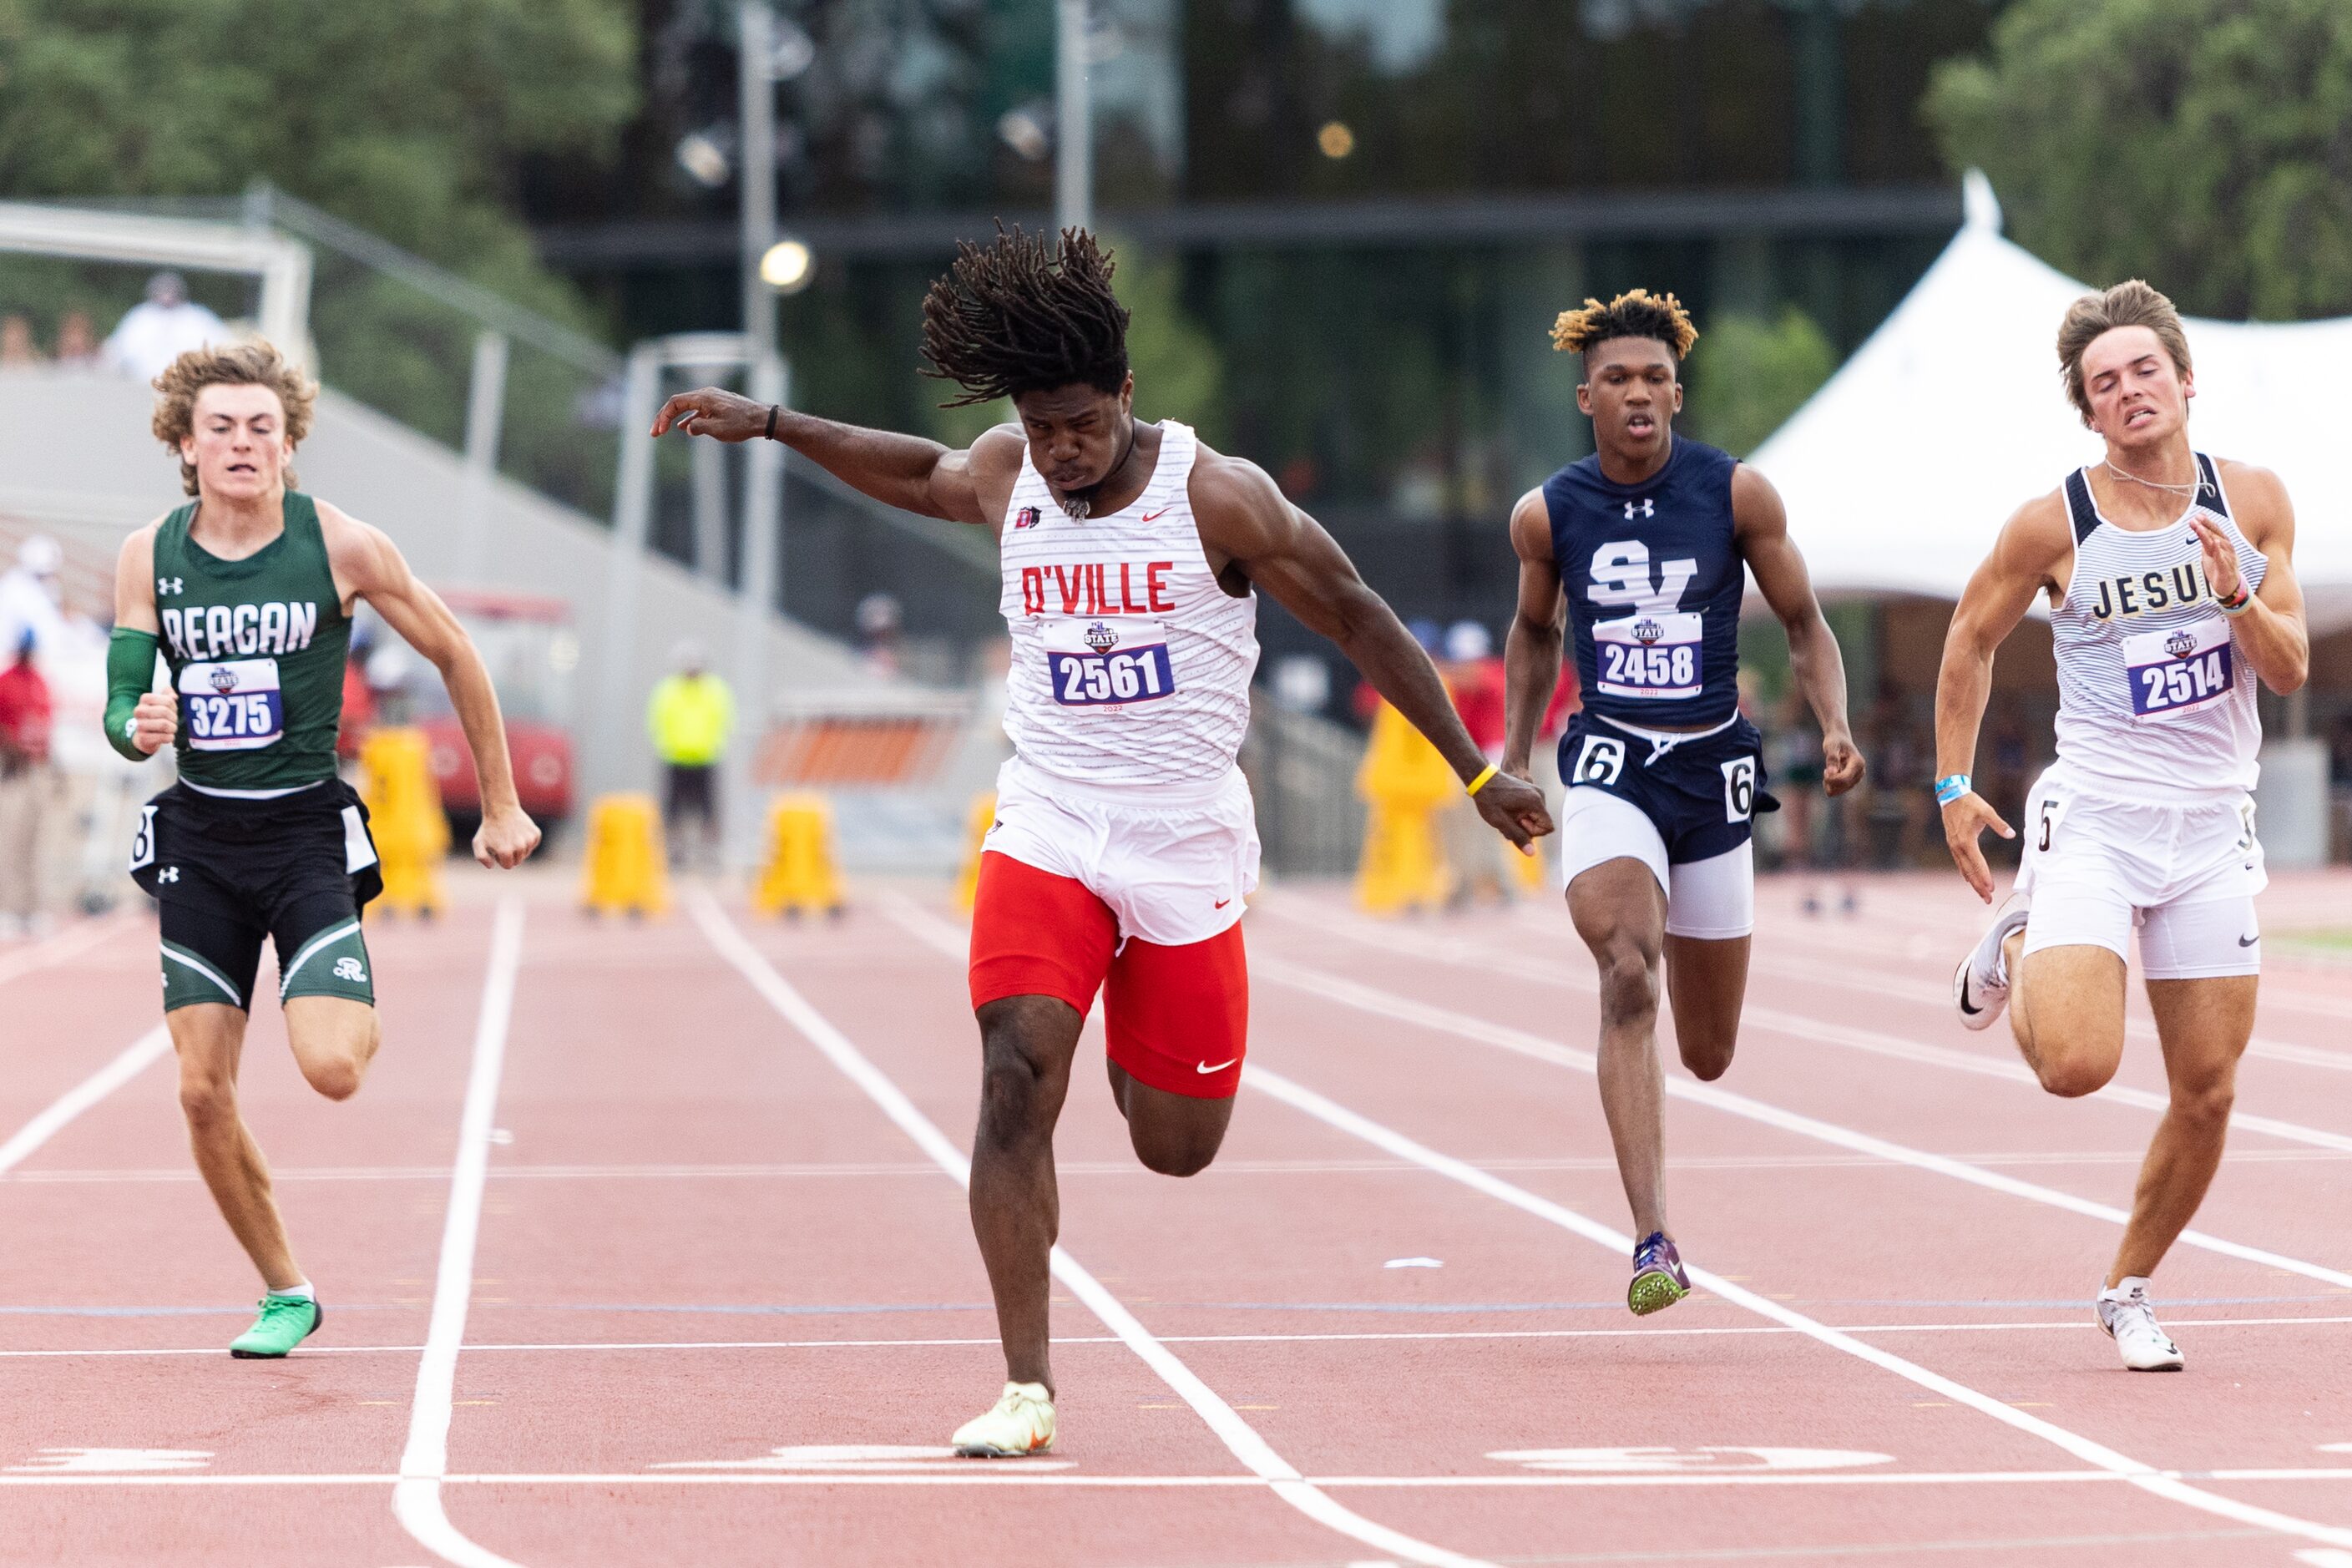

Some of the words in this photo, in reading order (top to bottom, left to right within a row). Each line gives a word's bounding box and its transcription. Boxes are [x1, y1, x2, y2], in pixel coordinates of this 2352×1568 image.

[1021, 561, 1176, 616] D'VILLE
[1587, 539, 1698, 615] SV
[161, 601, 317, 661] REAGAN
[1084, 633, 1120, 644] STATE
[1631, 627, 1664, 638] STATE
[2164, 637, 2198, 652] STATE
[1060, 650, 1161, 701] 2561
[1605, 644, 1694, 685] 2458
[2142, 650, 2225, 709] 2514
[190, 693, 273, 737] 3275
[1581, 742, 1617, 784] 6
[1730, 763, 1753, 815] 6
[2039, 800, 2060, 852] 5
